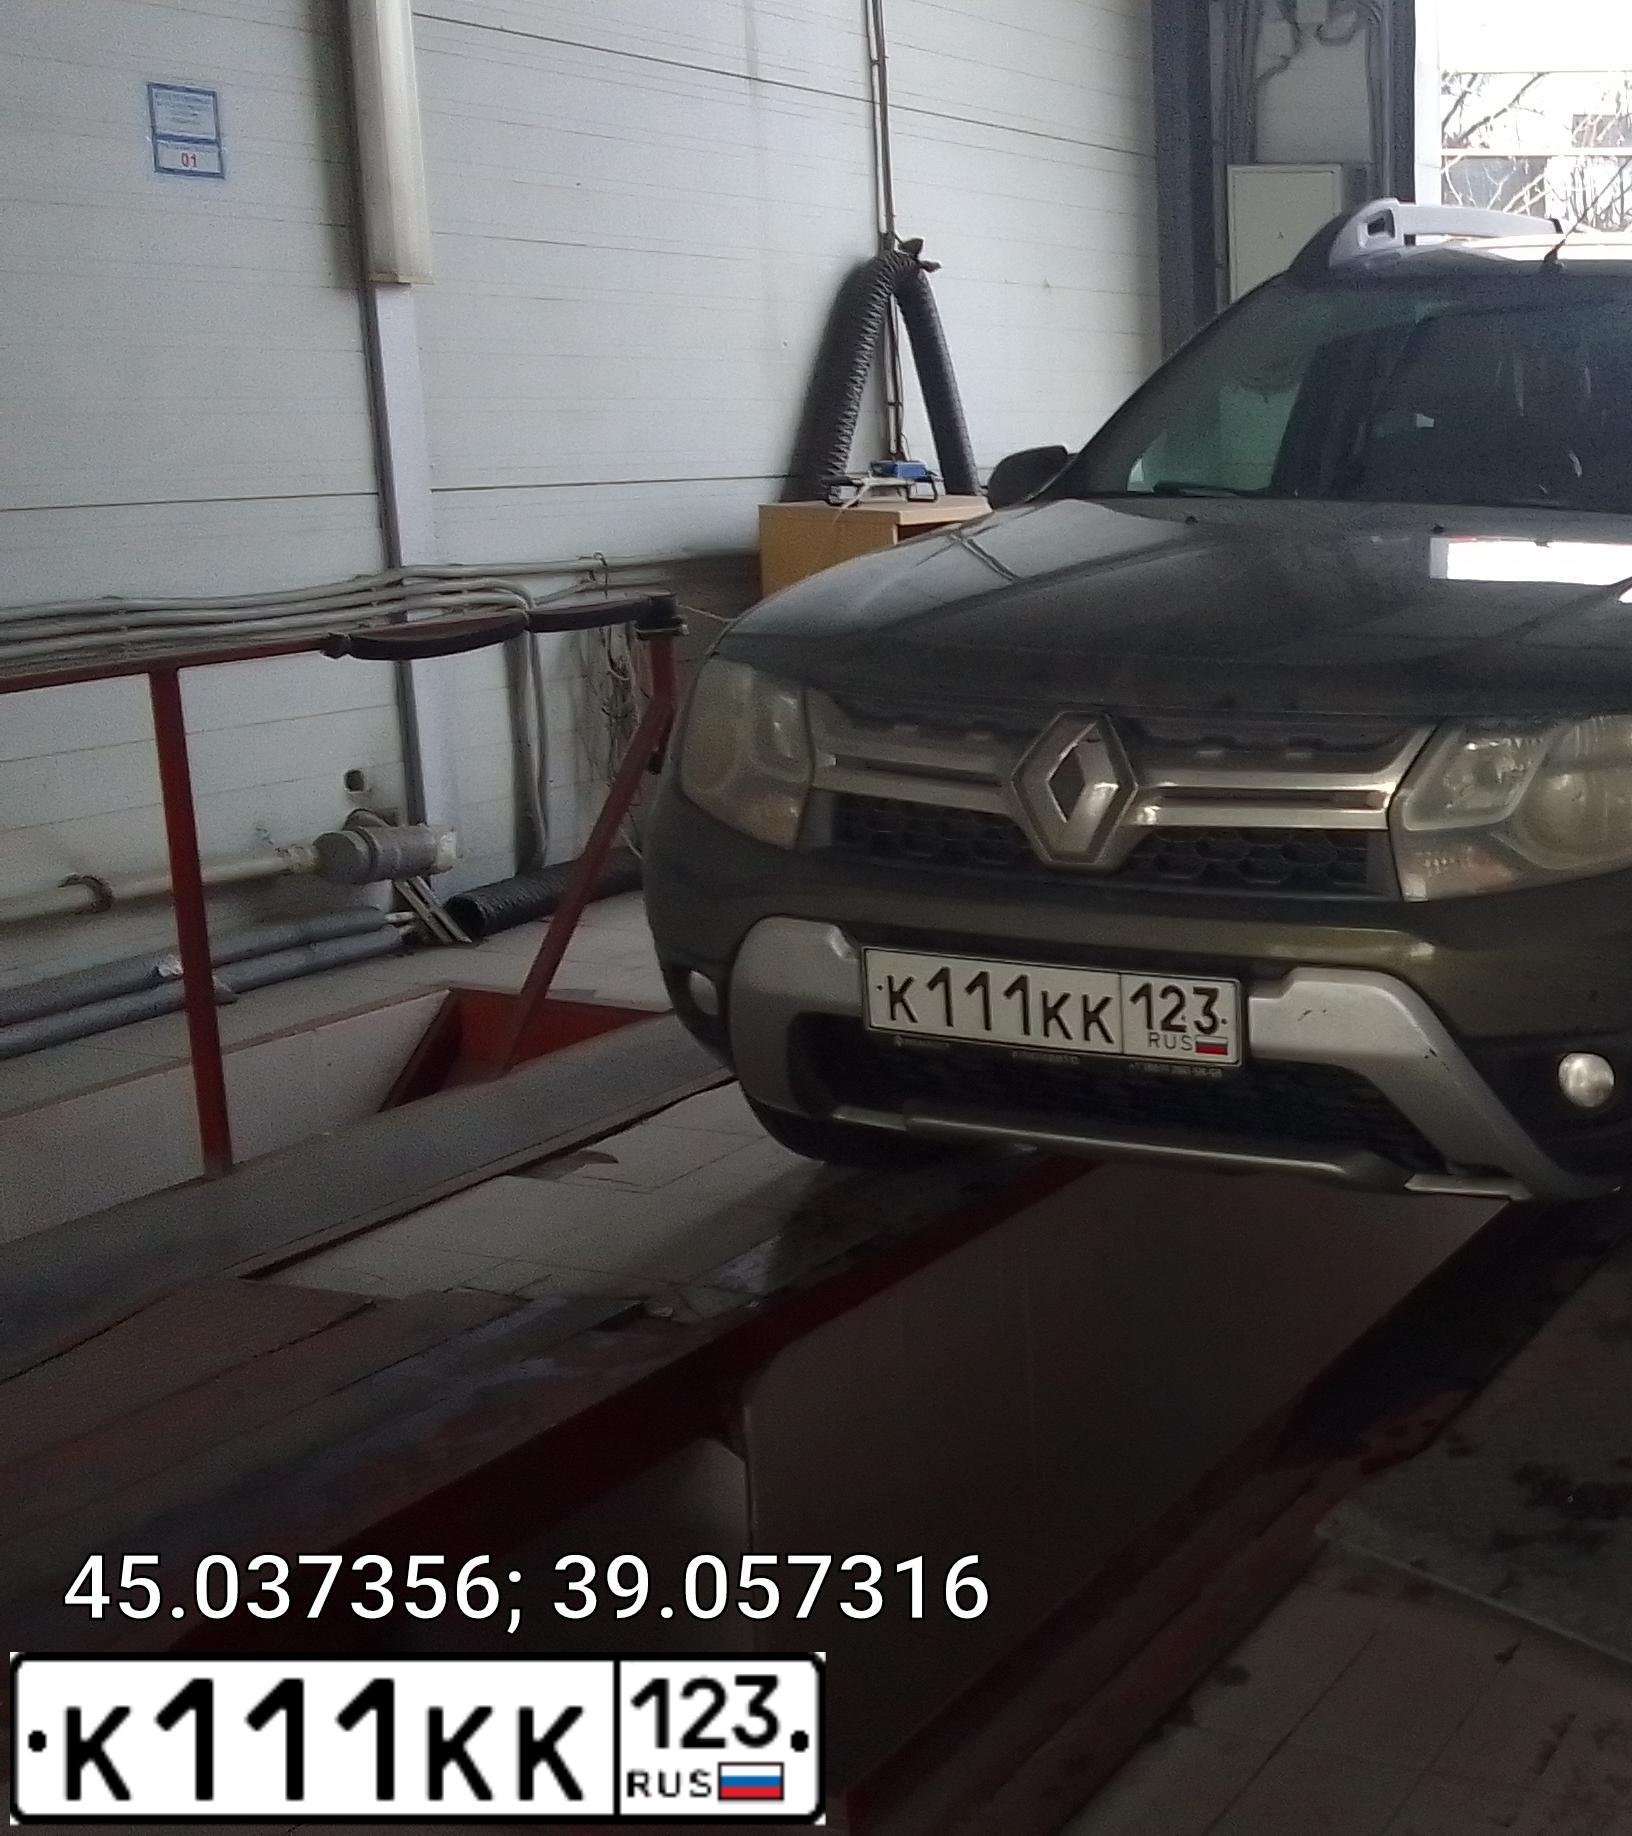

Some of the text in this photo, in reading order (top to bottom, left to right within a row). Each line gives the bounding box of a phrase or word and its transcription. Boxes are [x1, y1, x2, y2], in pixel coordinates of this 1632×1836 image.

[181, 152, 197, 167] 01
[887, 966, 1114, 1045] К111КК
[1130, 982, 1219, 1036] 123
[1148, 1031, 1193, 1052] RUS
